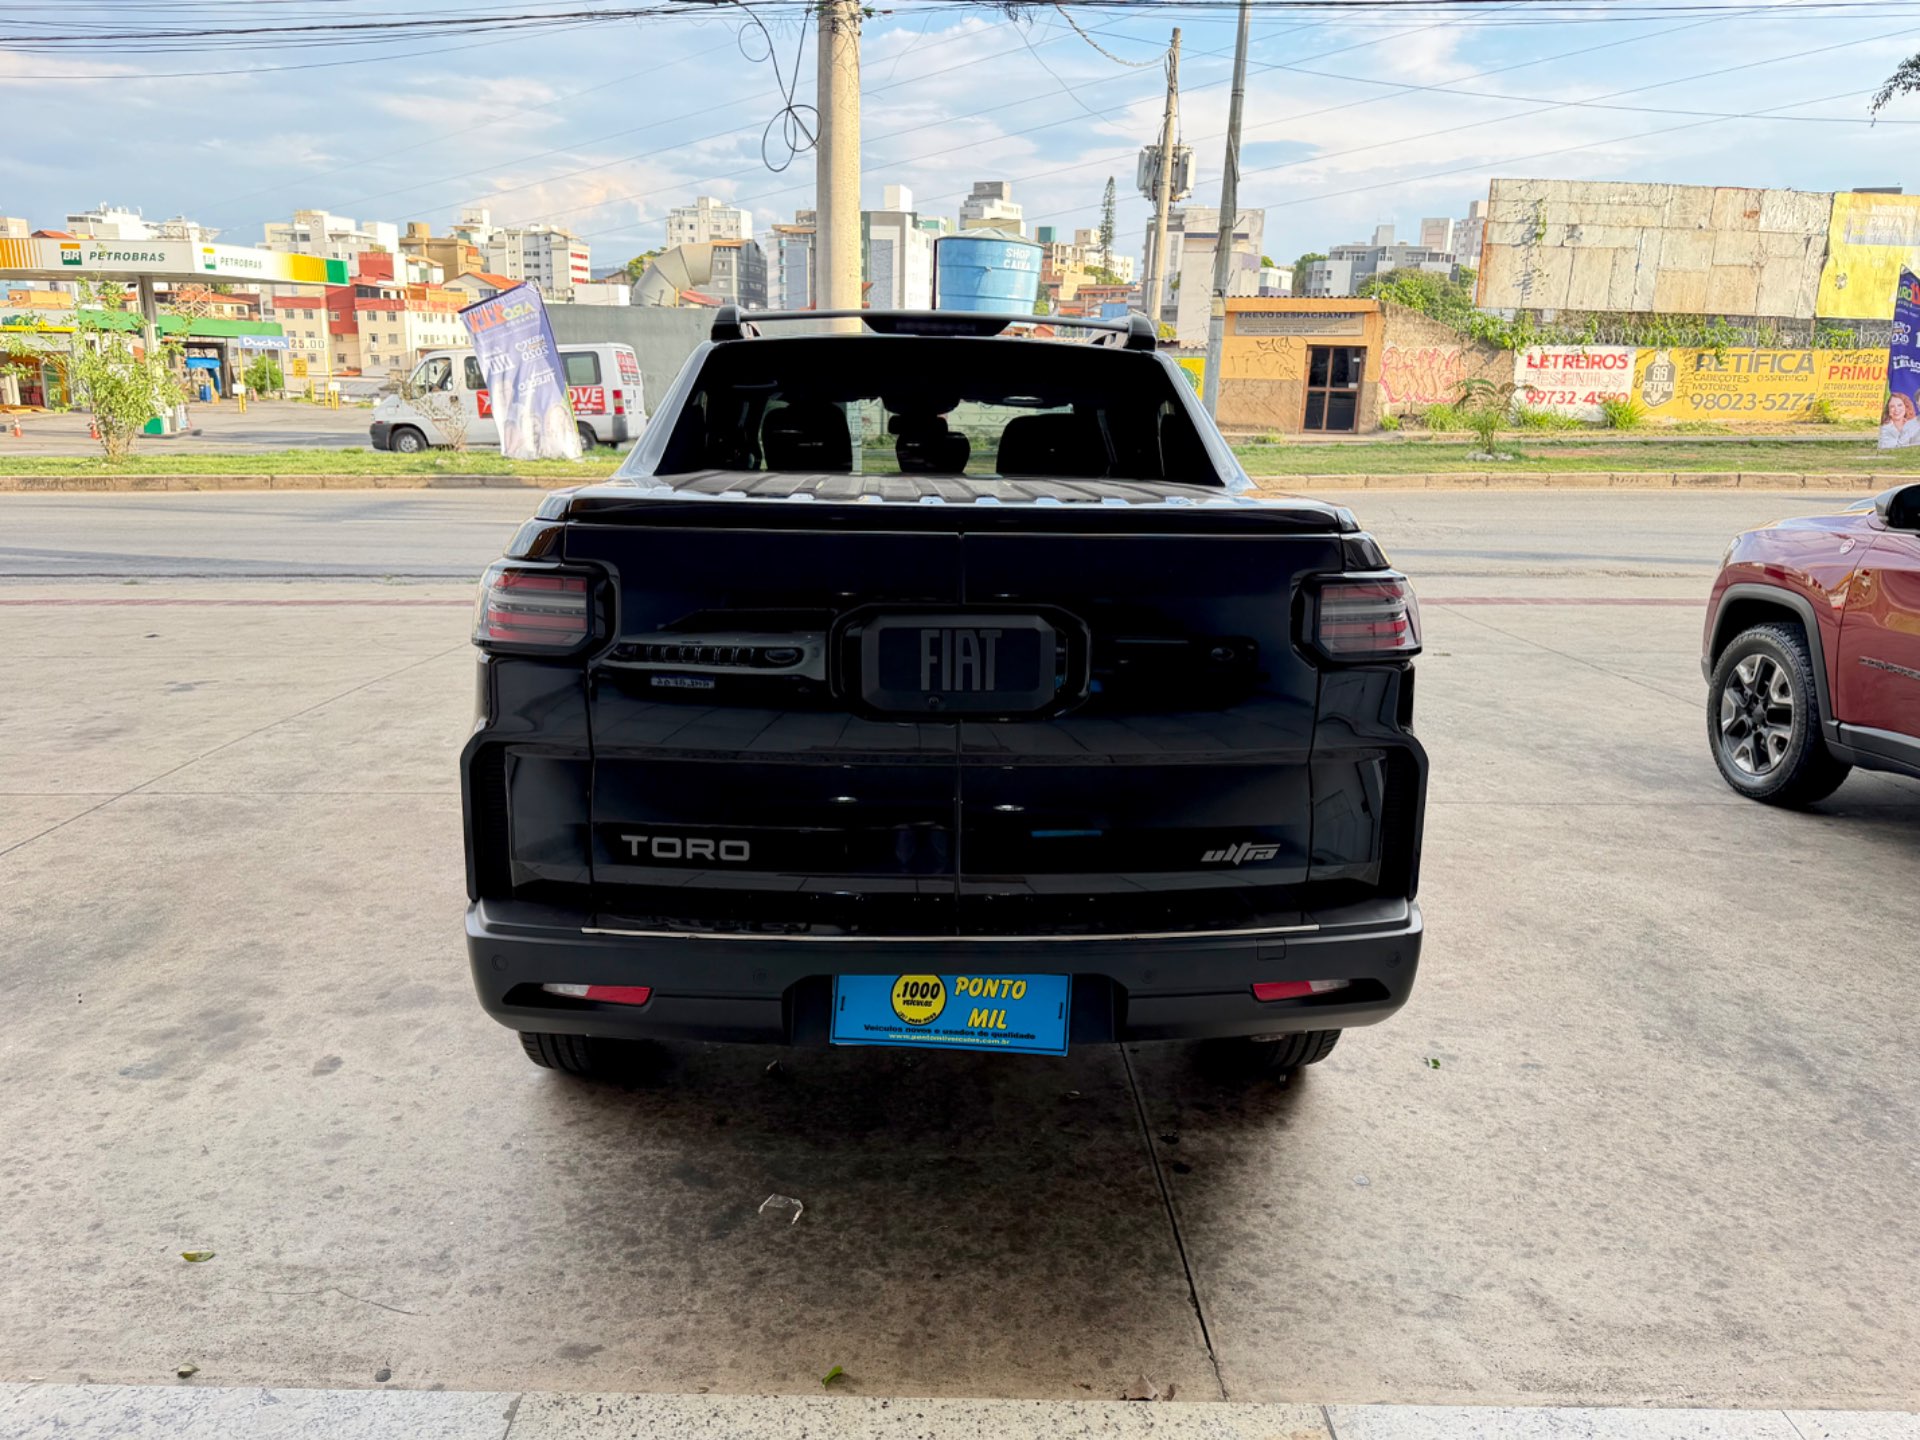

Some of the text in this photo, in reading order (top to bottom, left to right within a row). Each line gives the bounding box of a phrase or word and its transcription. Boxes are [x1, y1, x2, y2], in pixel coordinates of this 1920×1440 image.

[64, 251, 80, 261] BR
[89, 251, 166, 262] PETROBRAS
[220, 258, 263, 270] PETROBRAS
[242, 336, 287, 348] Ducha
[1526, 353, 1629, 370] LETREIROS
[920, 628, 1002, 691] FIAT
[620, 834, 750, 861] TORO
[954, 975, 1027, 1000] PONTO
[967, 1007, 1008, 1030] MIL
[942, 1028, 975, 1036] usados
[991, 1031, 1036, 1040] qualidade
